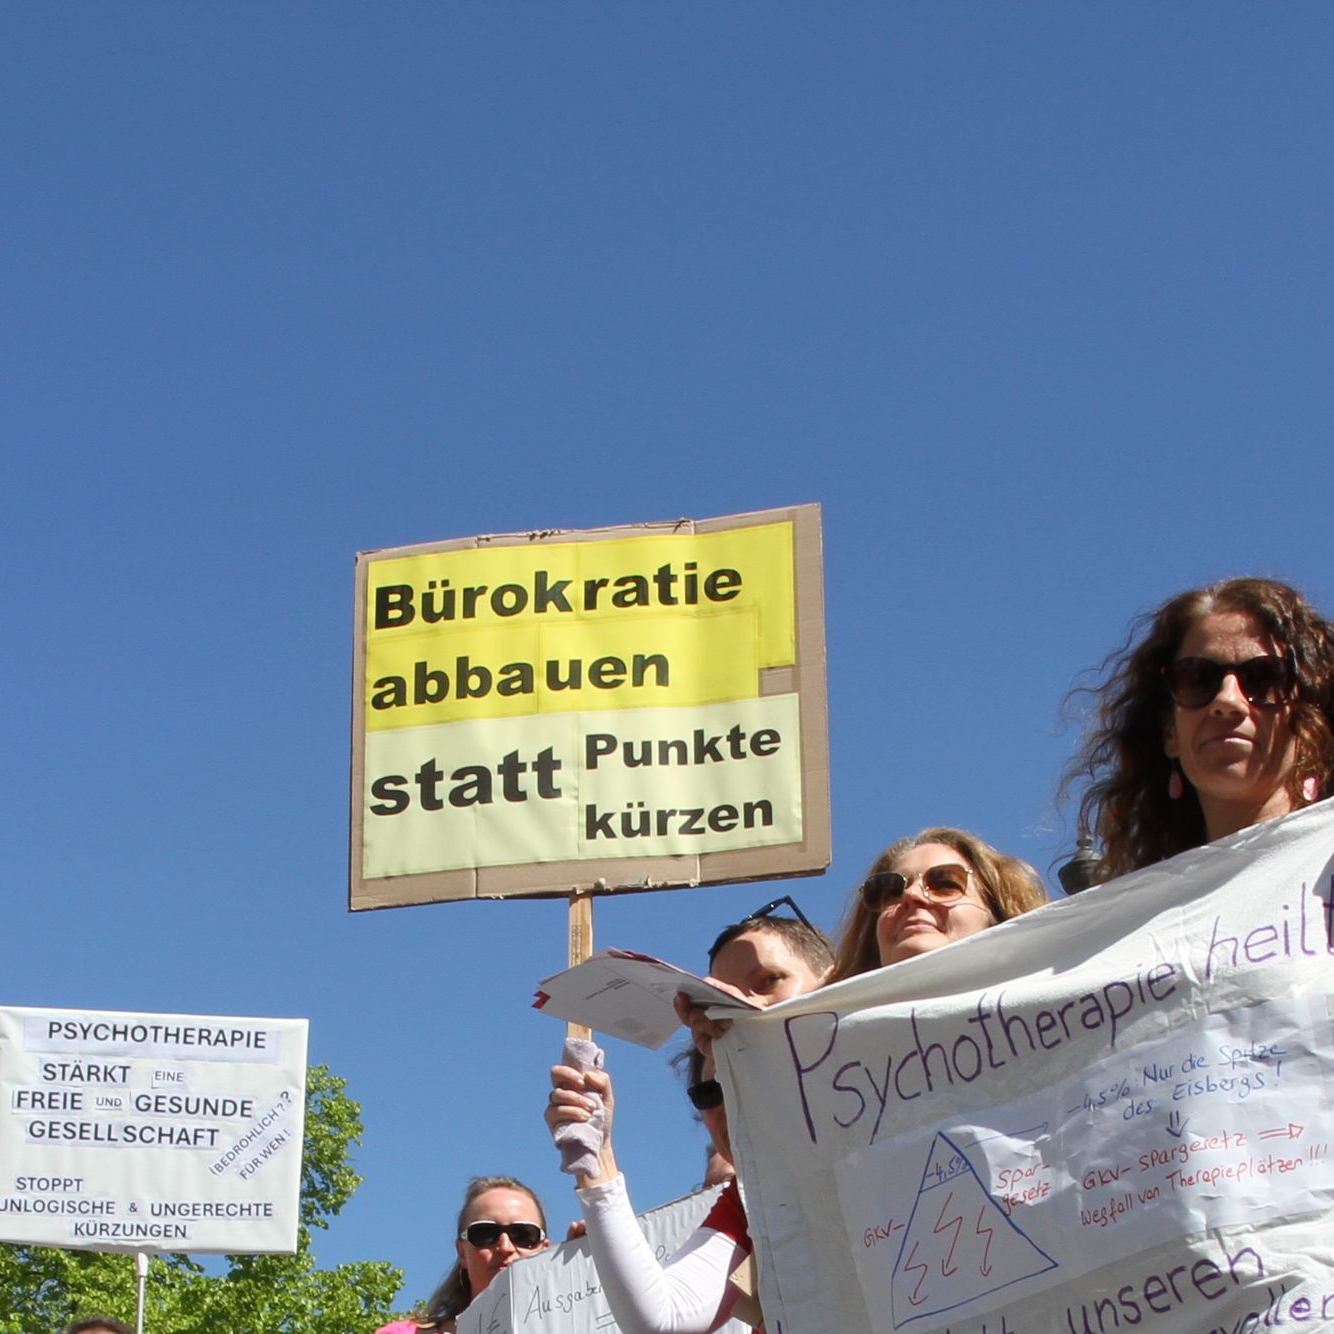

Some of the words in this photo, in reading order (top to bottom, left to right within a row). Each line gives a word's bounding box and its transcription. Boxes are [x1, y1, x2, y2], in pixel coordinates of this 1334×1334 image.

[374, 561, 743, 631] Bürokratie
[371, 653, 670, 711] abbauen
[370, 746, 562, 817] statt
[585, 723, 781, 770] Punkte
[585, 798, 774, 841] kürzen
[48, 1022, 267, 1049] PSYCHOTHERAPIE
[785, 962, 1178, 1145] Psychotherapie
[43, 1058, 131, 1083] STÄRKT
[154, 1070, 184, 1082] EINE
[16, 1091, 83, 1111] FREIE
[95, 1096, 122, 1108] UND
[135, 1094, 253, 1118] GESUNDE
[28, 1120, 219, 1147] GESELLSCHAFT
[239, 1158, 263, 1180] FÜR
[16, 1177, 83, 1192] STOPPT
[129, 1203, 138, 1213] &
[151, 1203, 273, 1217] UNGERECHTE
[74, 1219, 187, 1238] KÜRZUNGEN
